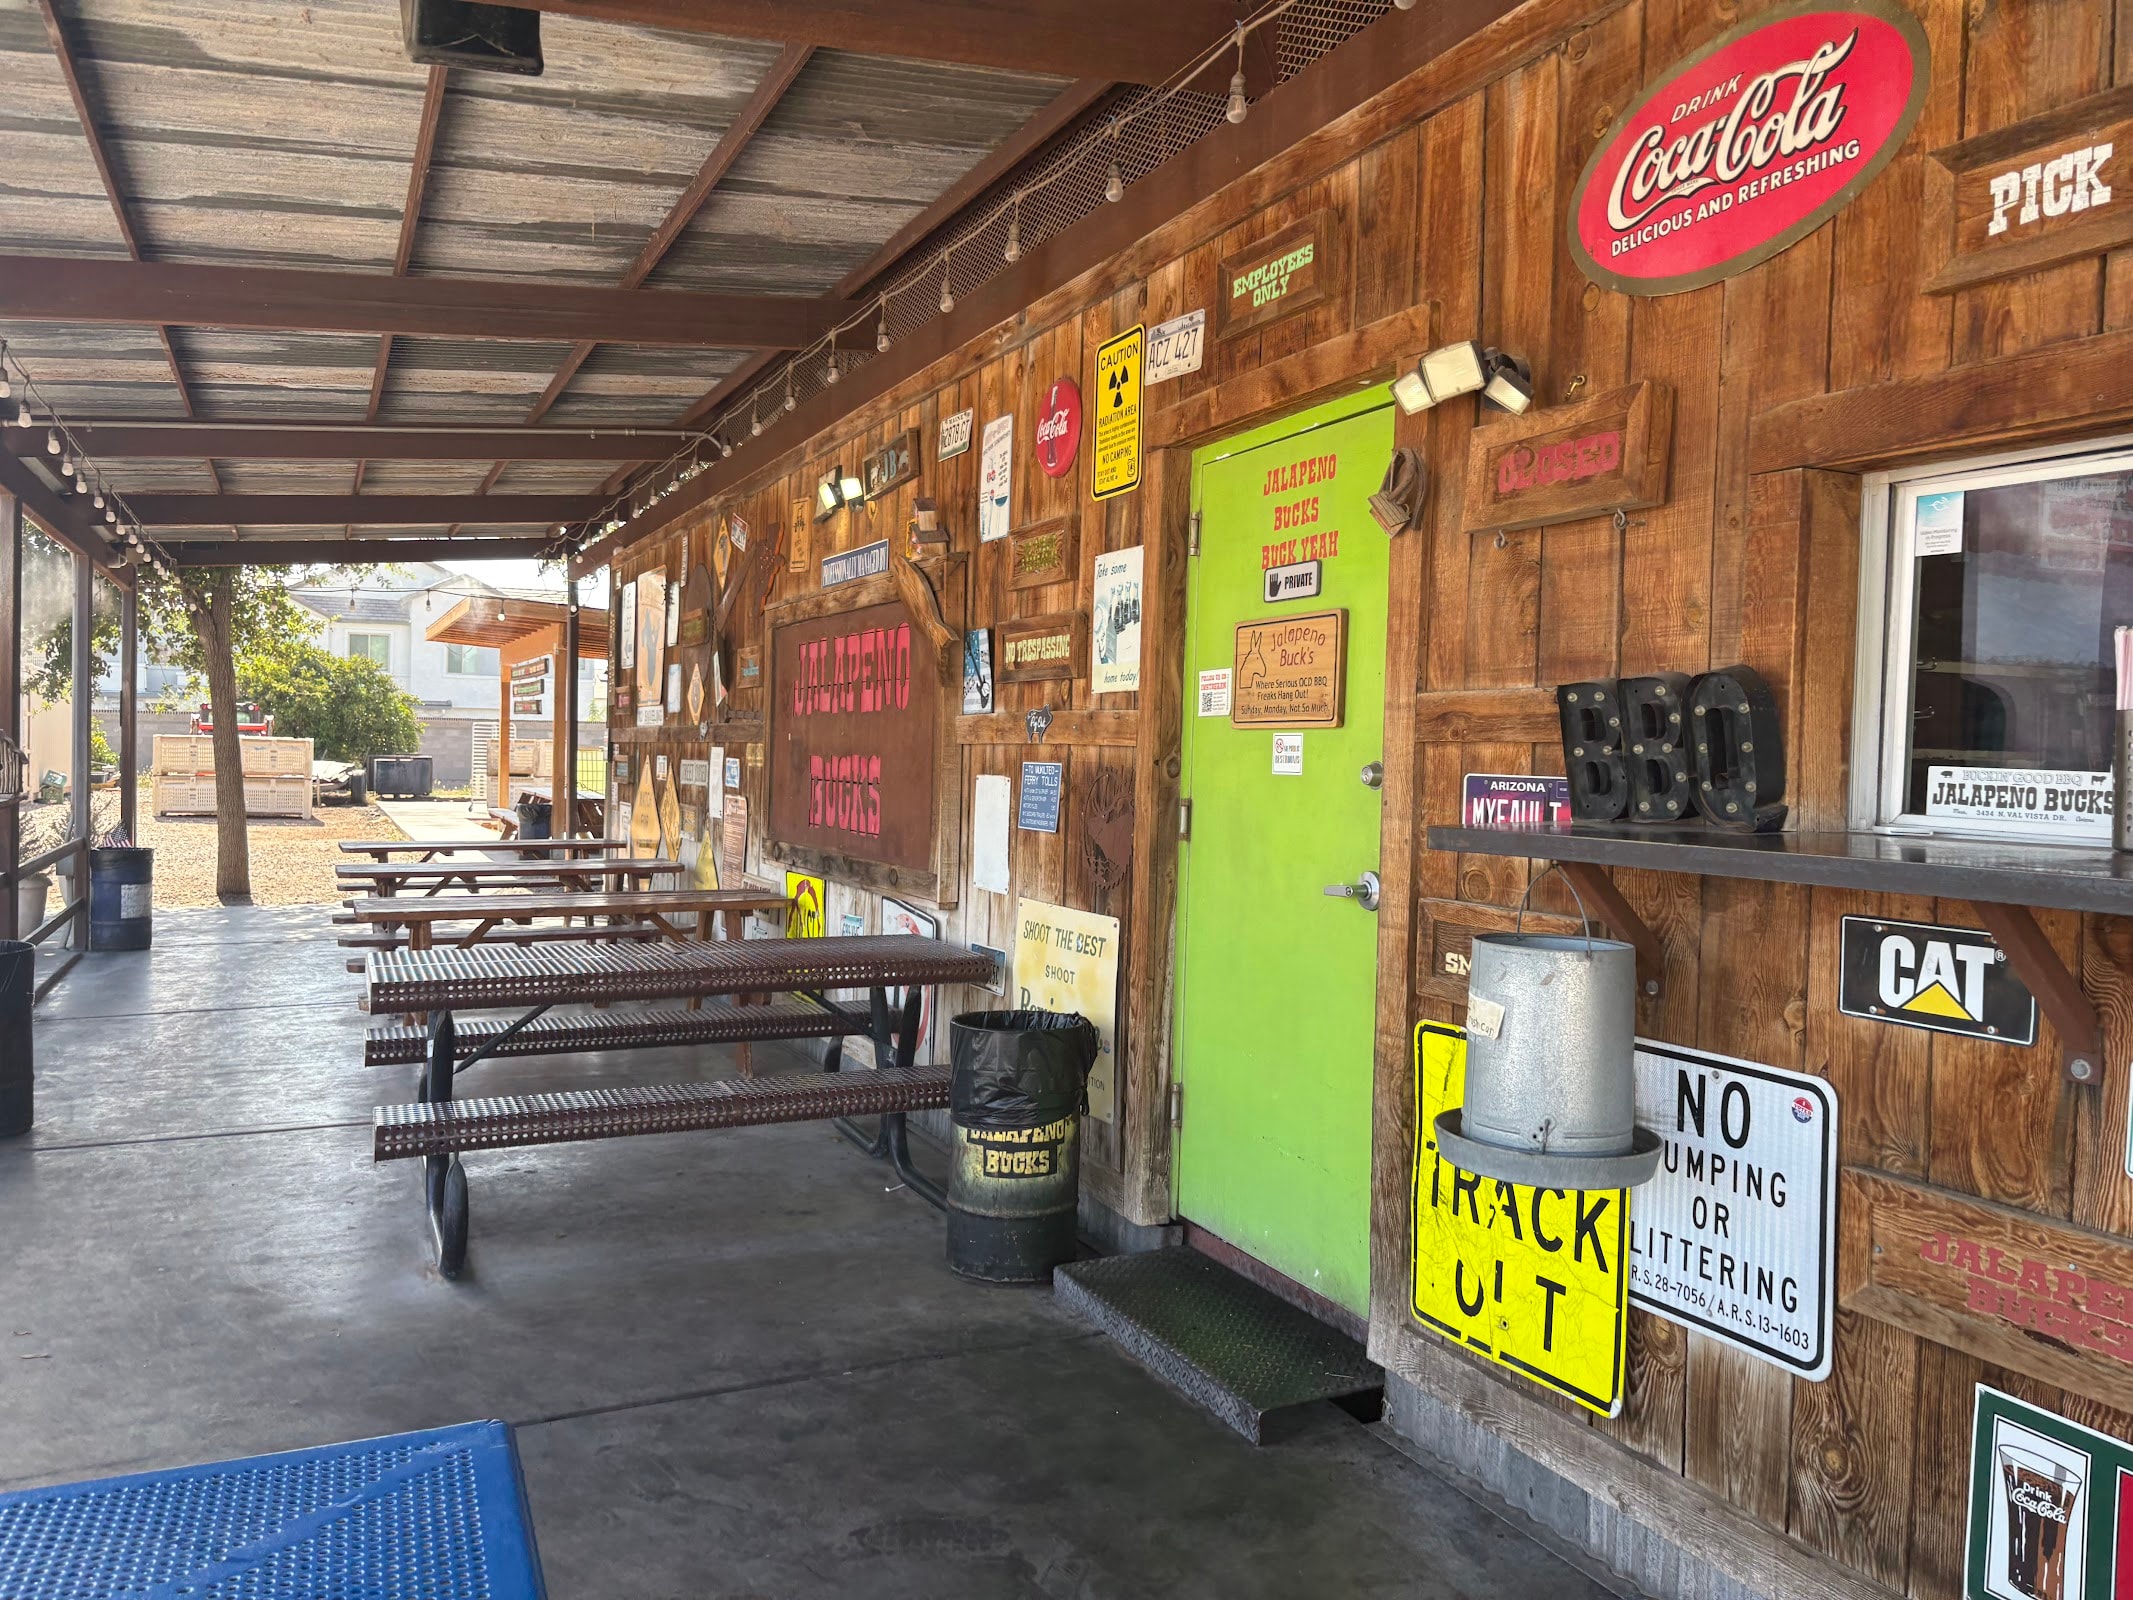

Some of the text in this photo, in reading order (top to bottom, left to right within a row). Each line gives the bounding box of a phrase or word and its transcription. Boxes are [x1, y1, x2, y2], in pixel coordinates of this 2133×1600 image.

[1670, 73, 1742, 124] DRINK
[1606, 27, 1858, 232] Coca-Cola
[1610, 140, 1861, 257] DELICIOUS AND REFRESHING
[1988, 143, 2114, 237] PICK
[1233, 243, 1314, 299] EMPLOYEES
[1253, 276, 1290, 307] ONLY
[1100, 341, 1138, 370] CAUTION
[1148, 328, 1198, 370] ACZ 427
[1037, 408, 1070, 444] Coca-Cola
[1099, 408, 1124, 428] RADIATION
[1125, 403, 1137, 418] AREA
[943, 423, 960, 448] 2878
[881, 450, 898, 483] JB
[1102, 445, 1132, 465] NO CAMPING
[1498, 431, 1619, 493] CLOSED
[1263, 454, 1337, 496] JALAPENO
[1274, 497, 1319, 531] BUCKS
[1262, 530, 1339, 569] BUCK YEAH
[1096, 562, 1127, 579] Take some
[1284, 572, 1313, 590] PRIVATE
[1005, 634, 1070, 663] NO TRESPASSING
[1271, 626, 1326, 651] Jalapeno
[793, 622, 910, 717] JALAPENO
[1280, 647, 1314, 666] Buck's
[1104, 669, 1138, 685] home today!
[1255, 676, 1327, 689] Where Serious OCD BBQ
[1241, 705, 1263, 716] Sunday,
[1264, 704, 1288, 714] Monday,
[1289, 704, 1301, 712] Not
[1302, 703, 1310, 712] So
[1257, 689, 1309, 701] Freaks Hang Out!
[1557, 664, 1788, 831] BBQ
[1024, 775, 1058, 787] FERRY TOLLS
[1490, 781, 1546, 793] ARIZONA
[2012, 772, 2053, 786] GOOD
[2056, 773, 2083, 787] BBQ
[809, 754, 881, 839] BUCKS
[1932, 782, 2113, 815] JALAPENO BUCKS
[1976, 809, 1995, 817] 3434
[1998, 810, 2006, 818] N.
[2007, 811, 2023, 819] VAL
[2025, 812, 2050, 821] VISTA
[2053, 814, 2067, 822] DR.
[1024, 920, 1107, 958] SHOOT THE BEST
[1045, 965, 1075, 985] SHOOT
[1879, 934, 1994, 1022] CAT
[1677, 1069, 1751, 1149] NO
[985, 1149, 1050, 1175] BUCKS
[1663, 1141, 1786, 1210] UMPING
[1426, 1140, 1610, 1274] TRACK
[1692, 1196, 1730, 1239] OR
[1630, 1221, 1798, 1314] LITTERING
[2023, 1482, 2052, 1502] Drink
